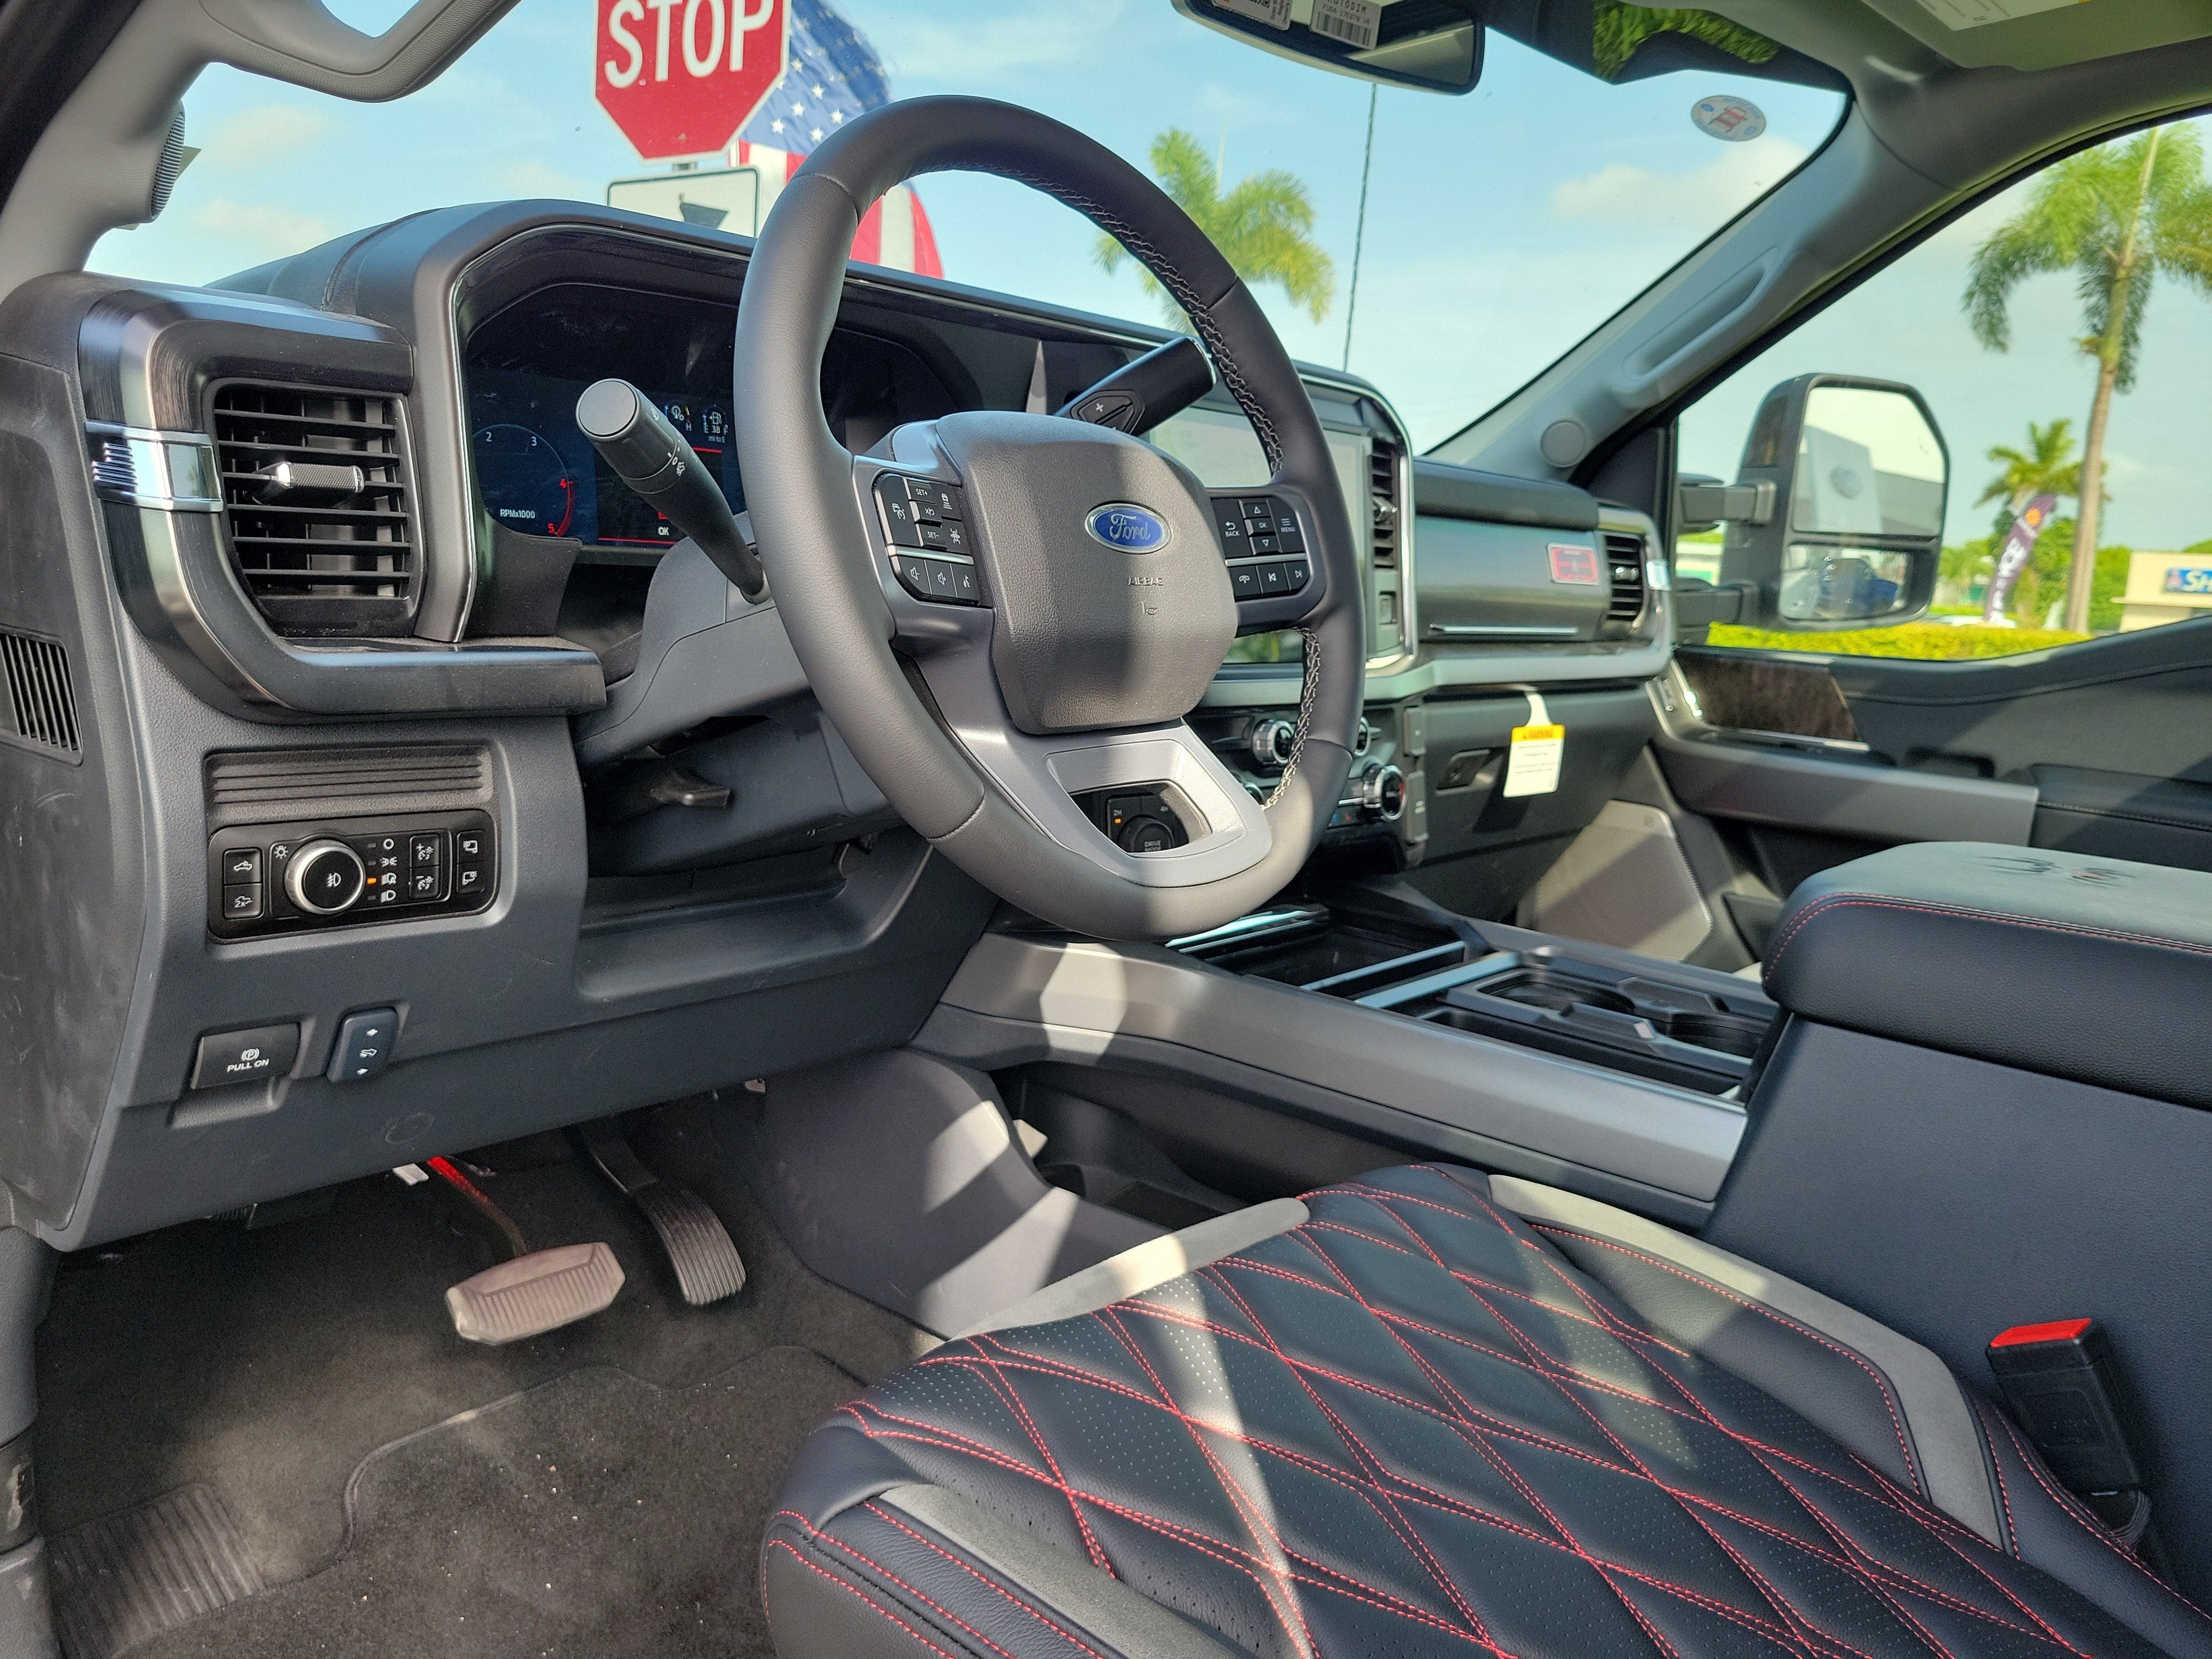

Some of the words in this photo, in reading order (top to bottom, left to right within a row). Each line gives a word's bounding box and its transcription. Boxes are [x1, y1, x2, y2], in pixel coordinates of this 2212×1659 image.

[605, 0, 773, 88] STOP
[486, 431, 493, 442] 2
[531, 436, 537, 446] 3
[559, 478, 567, 488] 4
[500, 508, 535, 519] RPMx1000
[548, 522, 555, 533] 5
[658, 526, 669, 535] OK
[1109, 513, 1150, 540] Ford
[1128, 577, 1164, 586] AIRBAG
[227, 1062, 252, 1073] PULL
[254, 1058, 269, 1068] ON
